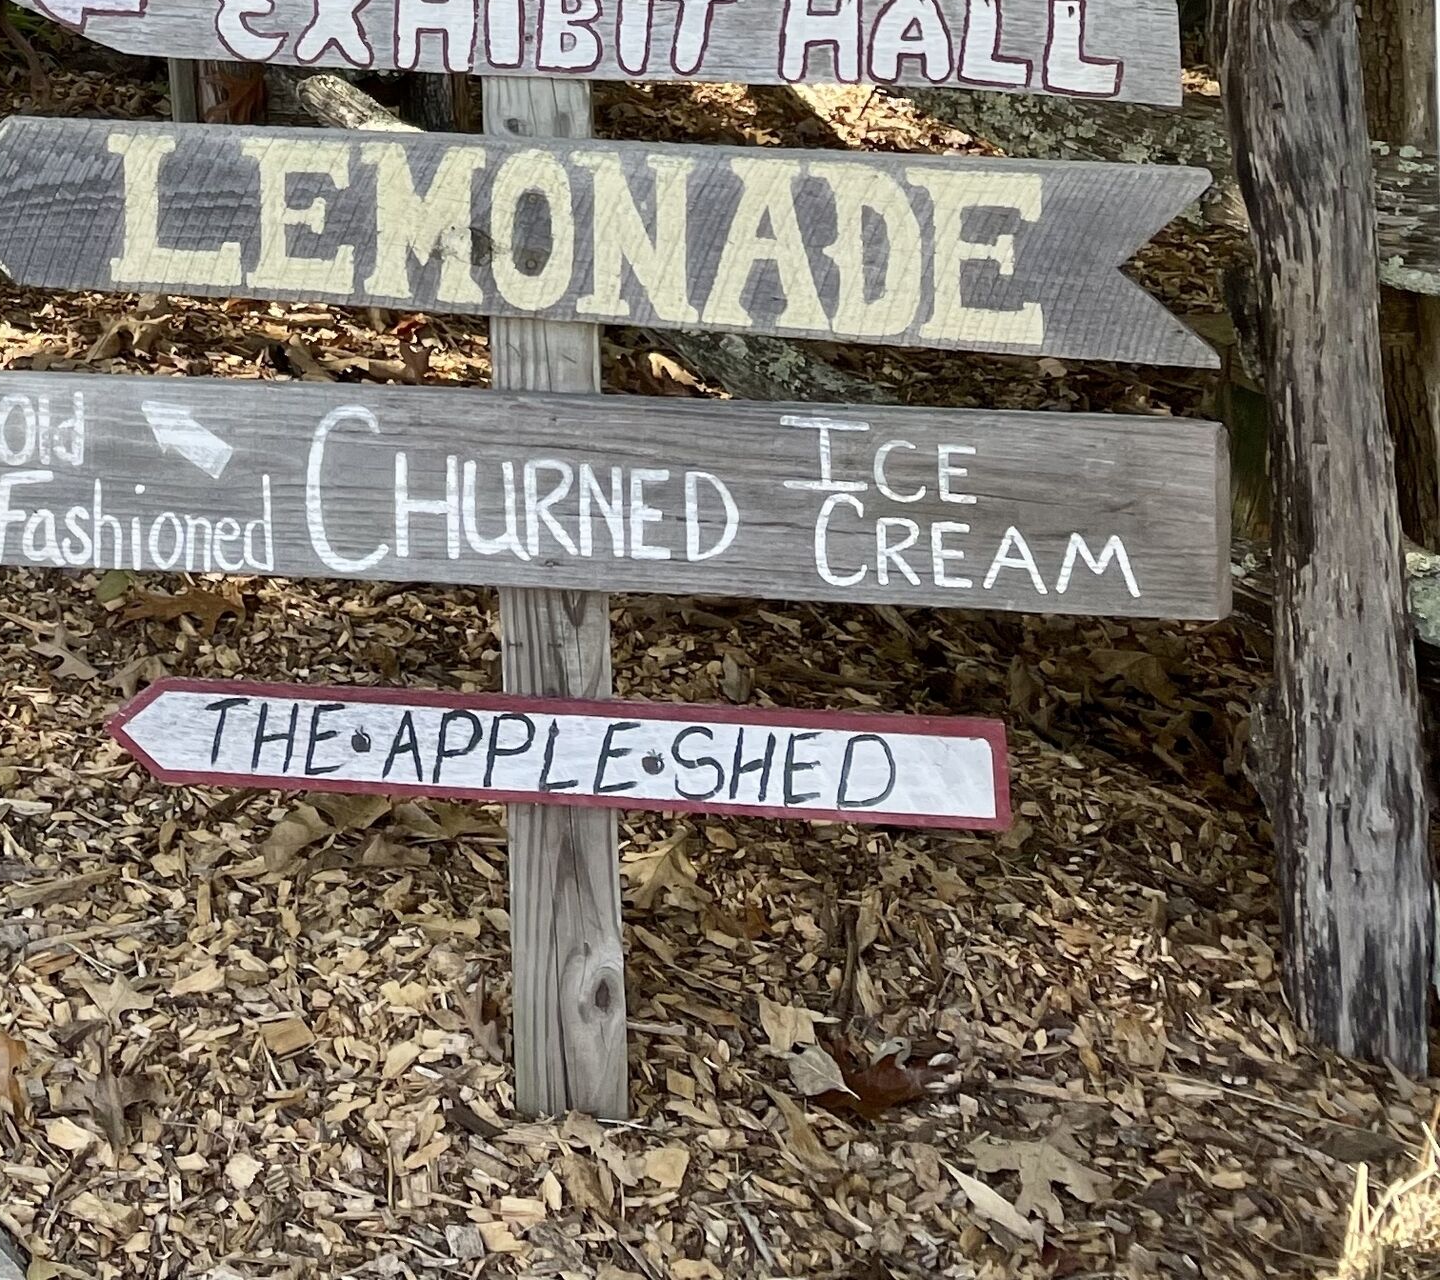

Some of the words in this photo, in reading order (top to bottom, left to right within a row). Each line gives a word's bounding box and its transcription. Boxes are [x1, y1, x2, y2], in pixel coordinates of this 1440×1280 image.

[106, 134, 1047, 346] LEMONADE
[305, 403, 740, 573] CHURNED
[779, 415, 978, 505] ICE
[814, 492, 1142, 598] CREAM
[204, 697, 347, 776] THE
[382, 708, 642, 795] APPLE
[670, 726, 897, 808] SHED
